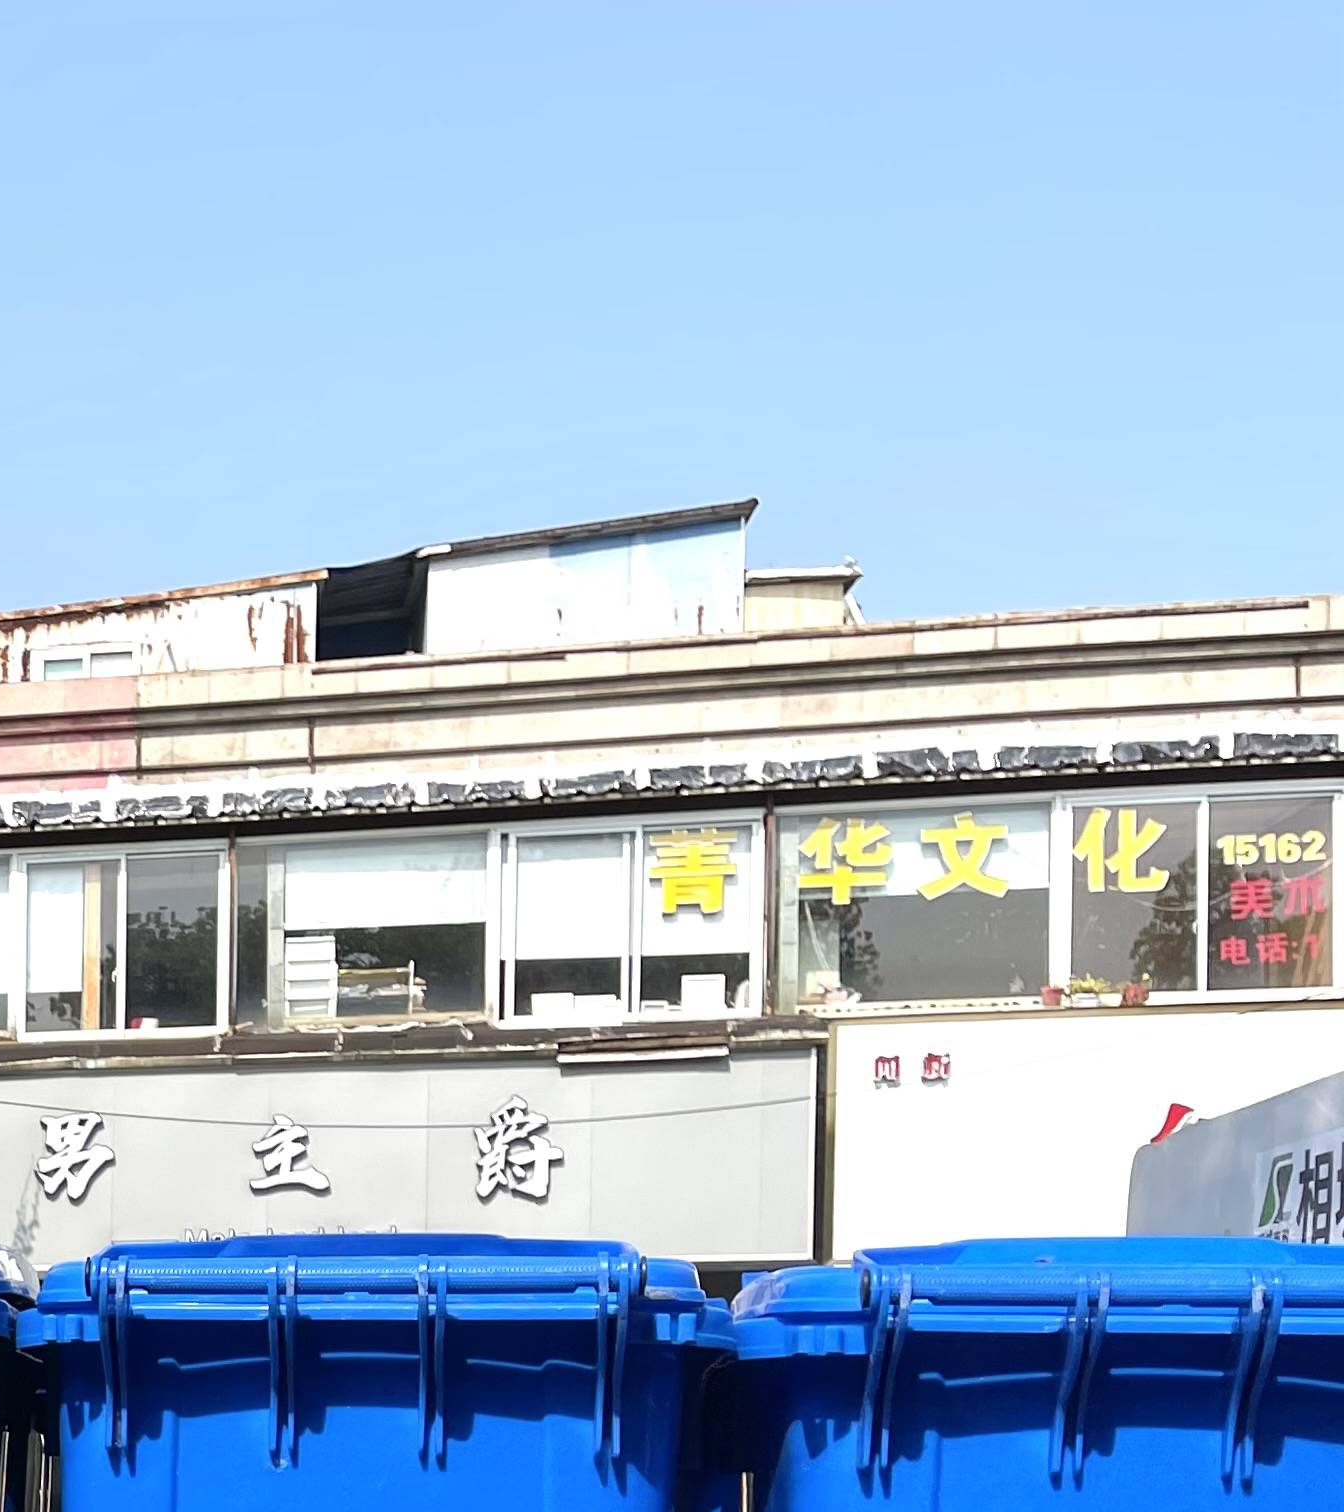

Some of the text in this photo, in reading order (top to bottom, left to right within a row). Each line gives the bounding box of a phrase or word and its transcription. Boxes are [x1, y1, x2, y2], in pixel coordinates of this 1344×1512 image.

[649, 807, 1170, 915] 菁华文化
[1216, 829, 1327, 865] 15162
[34, 1097, 563, 1201] 男主爵
